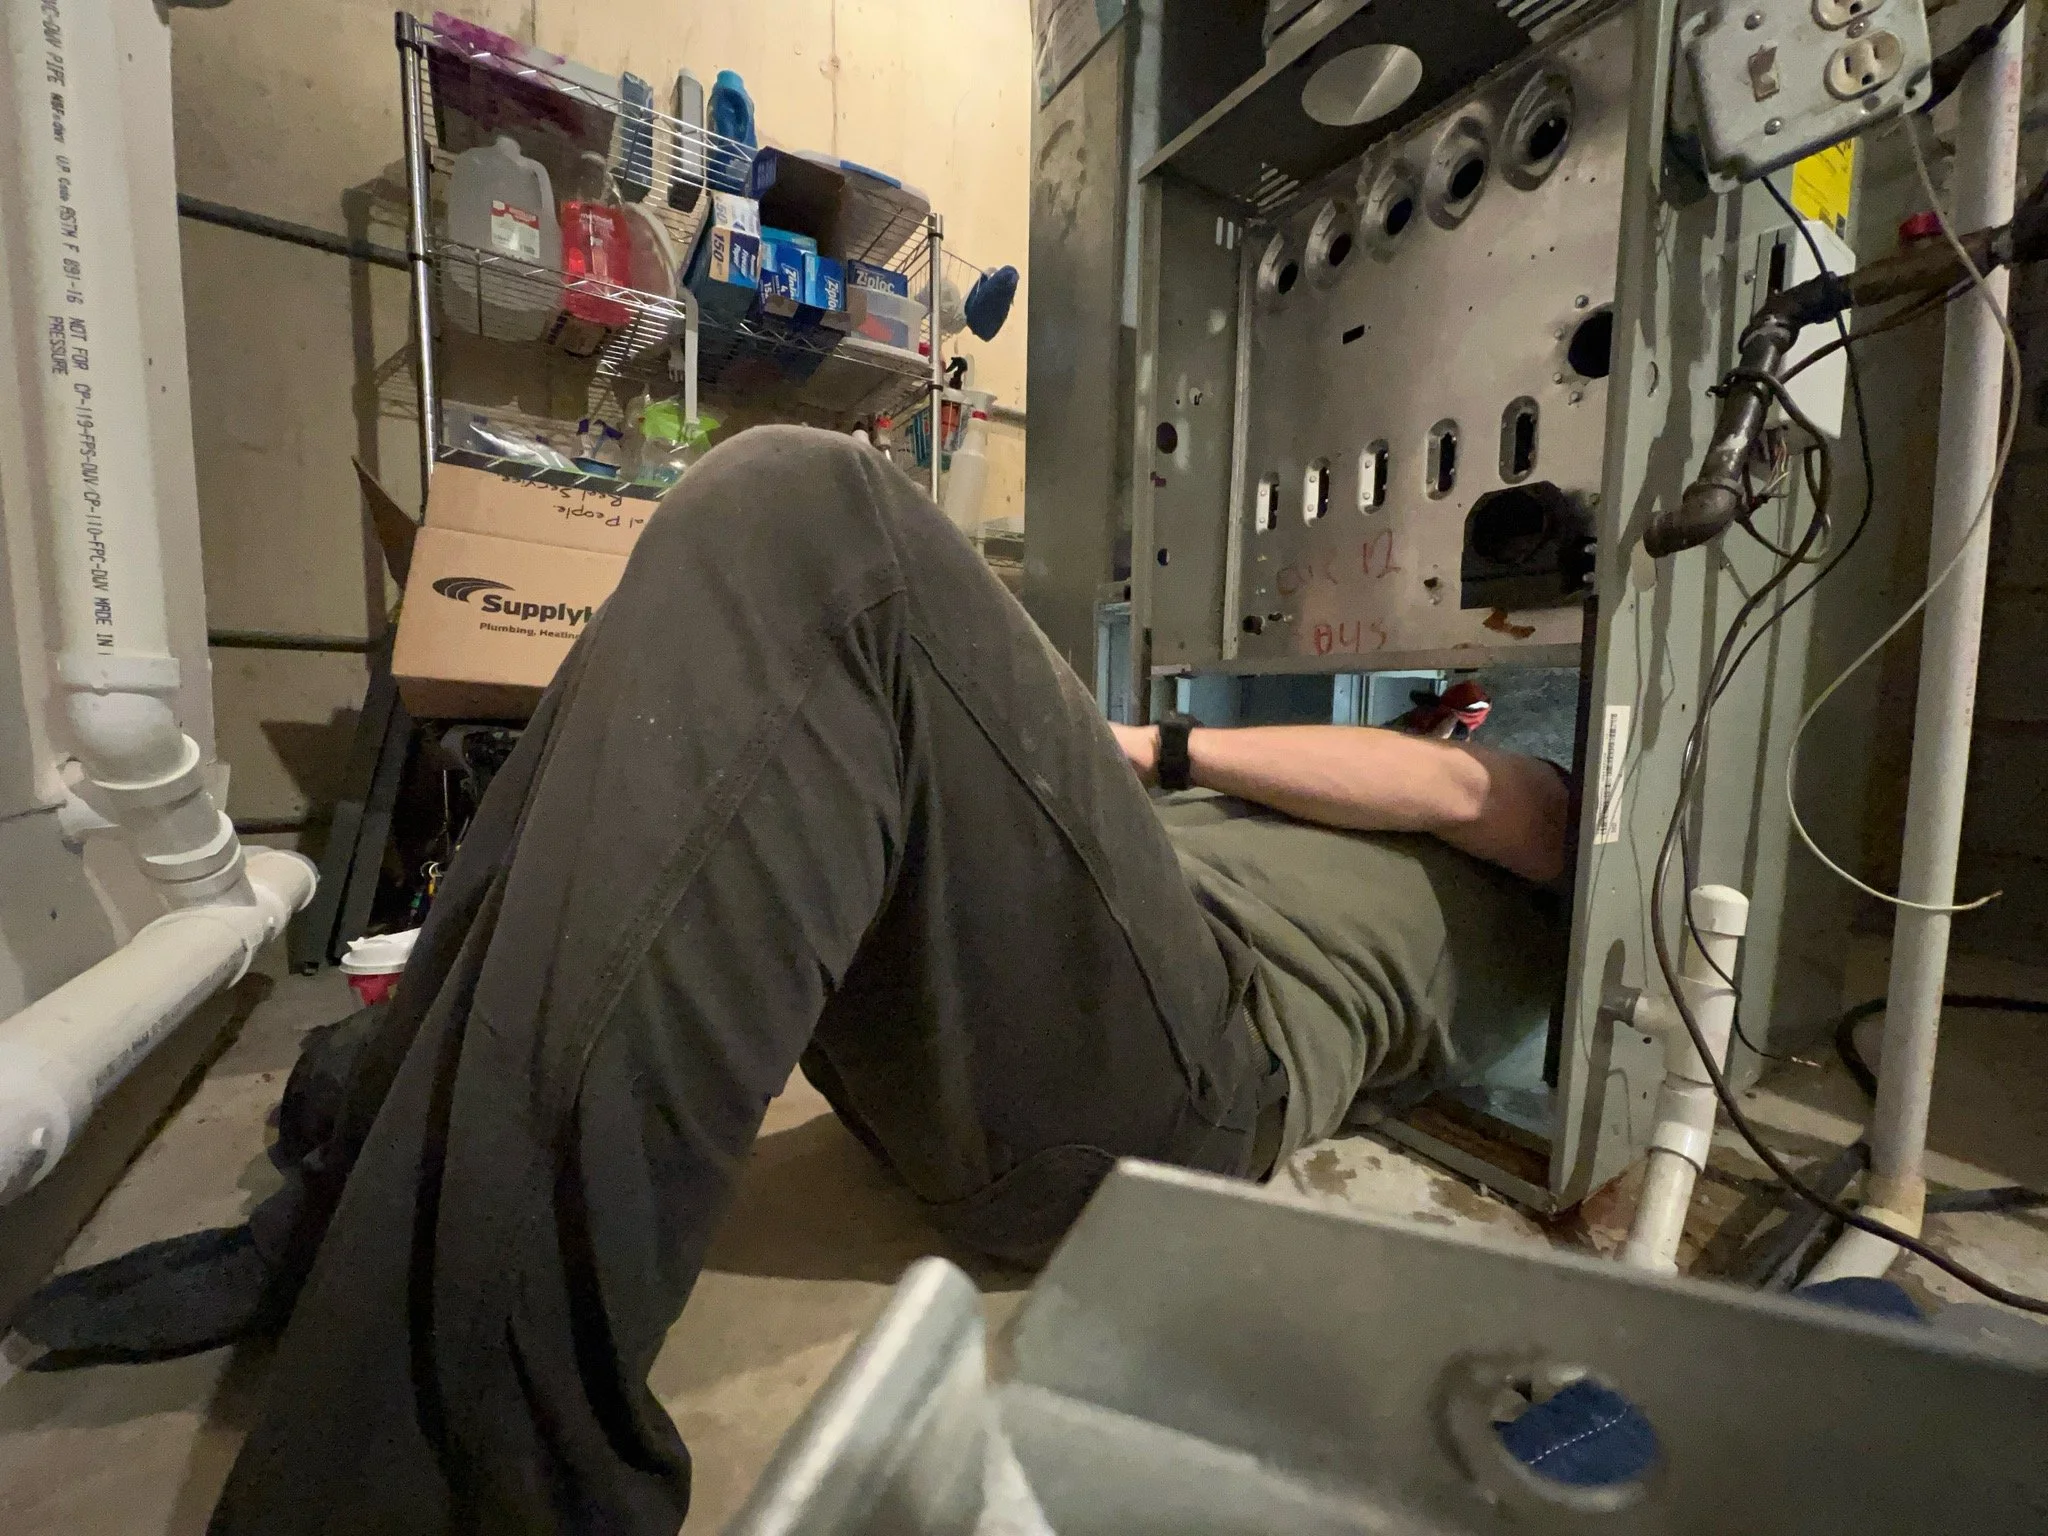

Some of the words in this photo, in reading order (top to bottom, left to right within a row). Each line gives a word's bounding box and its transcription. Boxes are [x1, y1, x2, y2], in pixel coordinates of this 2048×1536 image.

[46, 51, 66, 88] PIPE
[59, 206, 79, 239] ASTM
[62, 242, 80, 253] F
[63, 257, 84, 305] 891-16
[855, 269, 896, 295] Ziploc
[68, 317, 87, 342] NOT
[48, 316, 69, 375] PRESSURE
[71, 348, 90, 371] FOR
[94, 596, 113, 626] MADE
[96, 632, 113, 649] IN
[479, 621, 537, 637] Plumbing,
